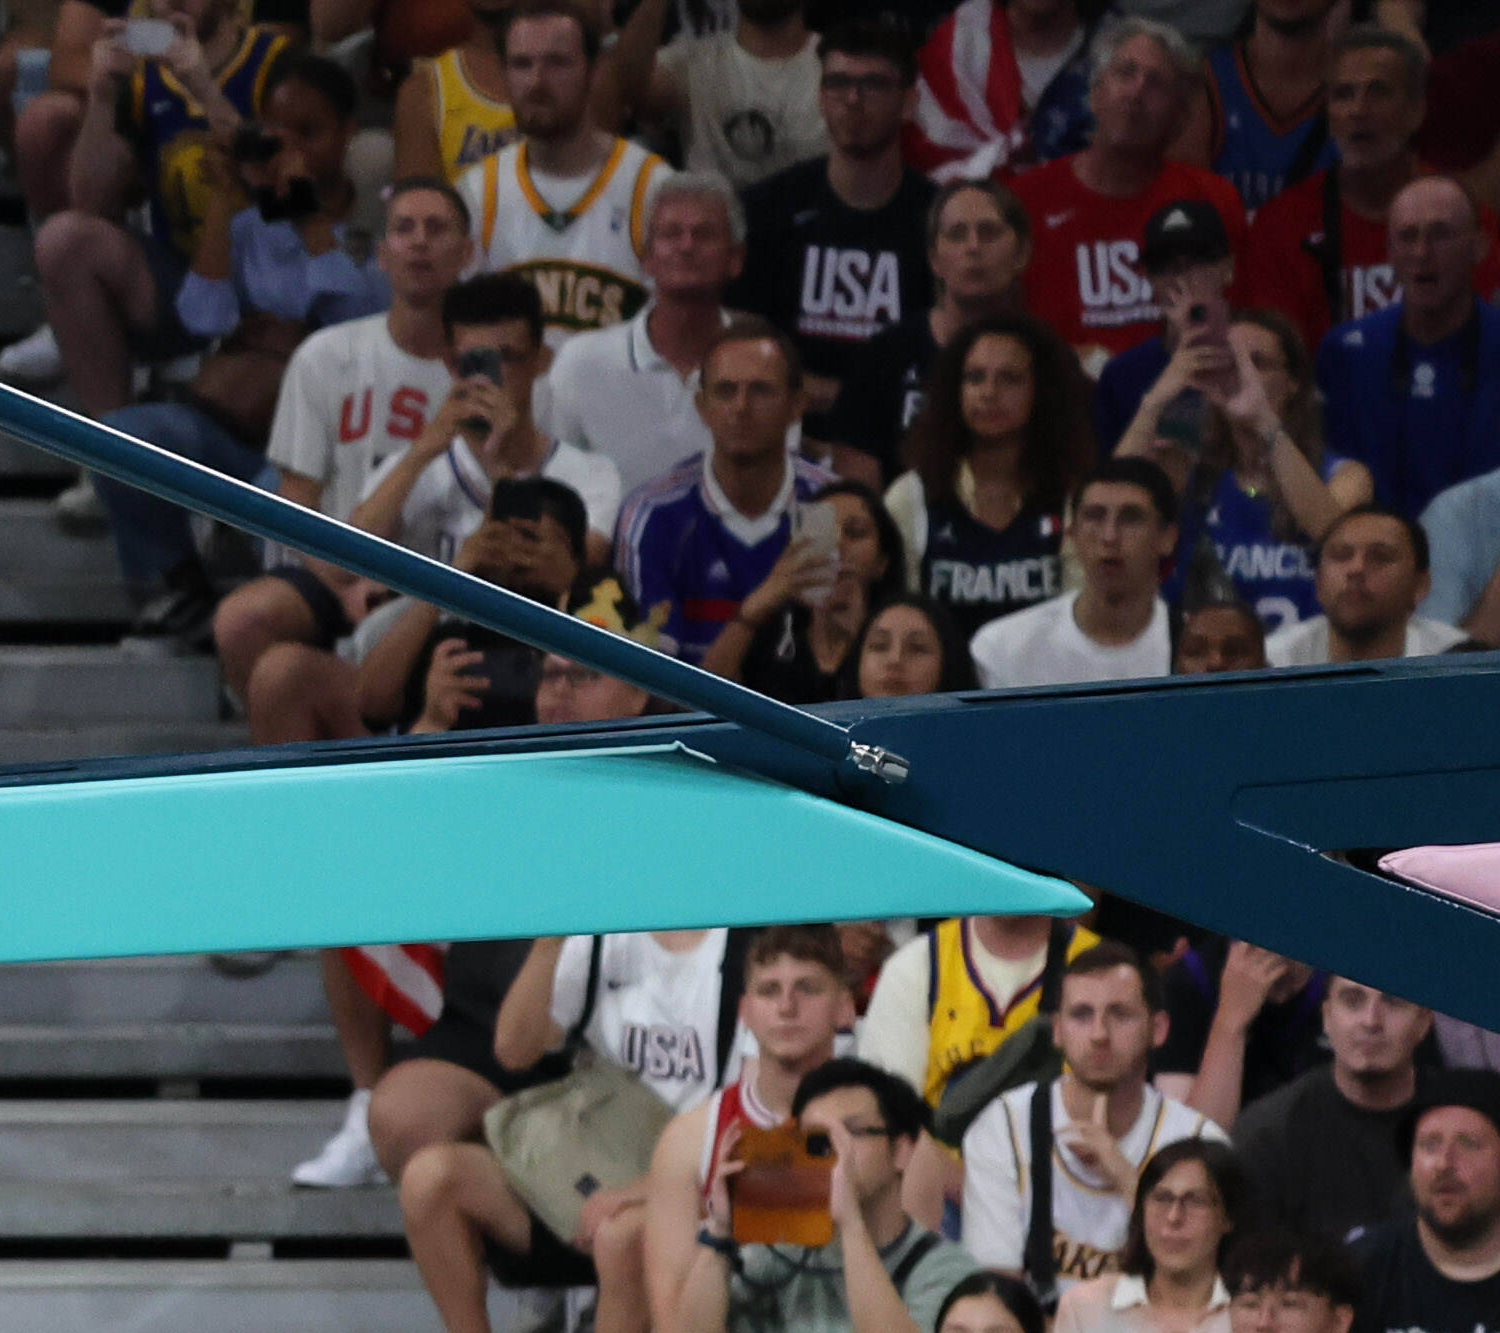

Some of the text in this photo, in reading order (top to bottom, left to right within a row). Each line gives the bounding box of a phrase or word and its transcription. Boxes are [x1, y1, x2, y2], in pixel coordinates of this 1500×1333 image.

[798, 244, 900, 324] USA
[1077, 240, 1157, 306] US
[930, 558, 1057, 602] FRANCE
[1216, 544, 1314, 582] ANCE
[622, 1022, 702, 1084] USA
